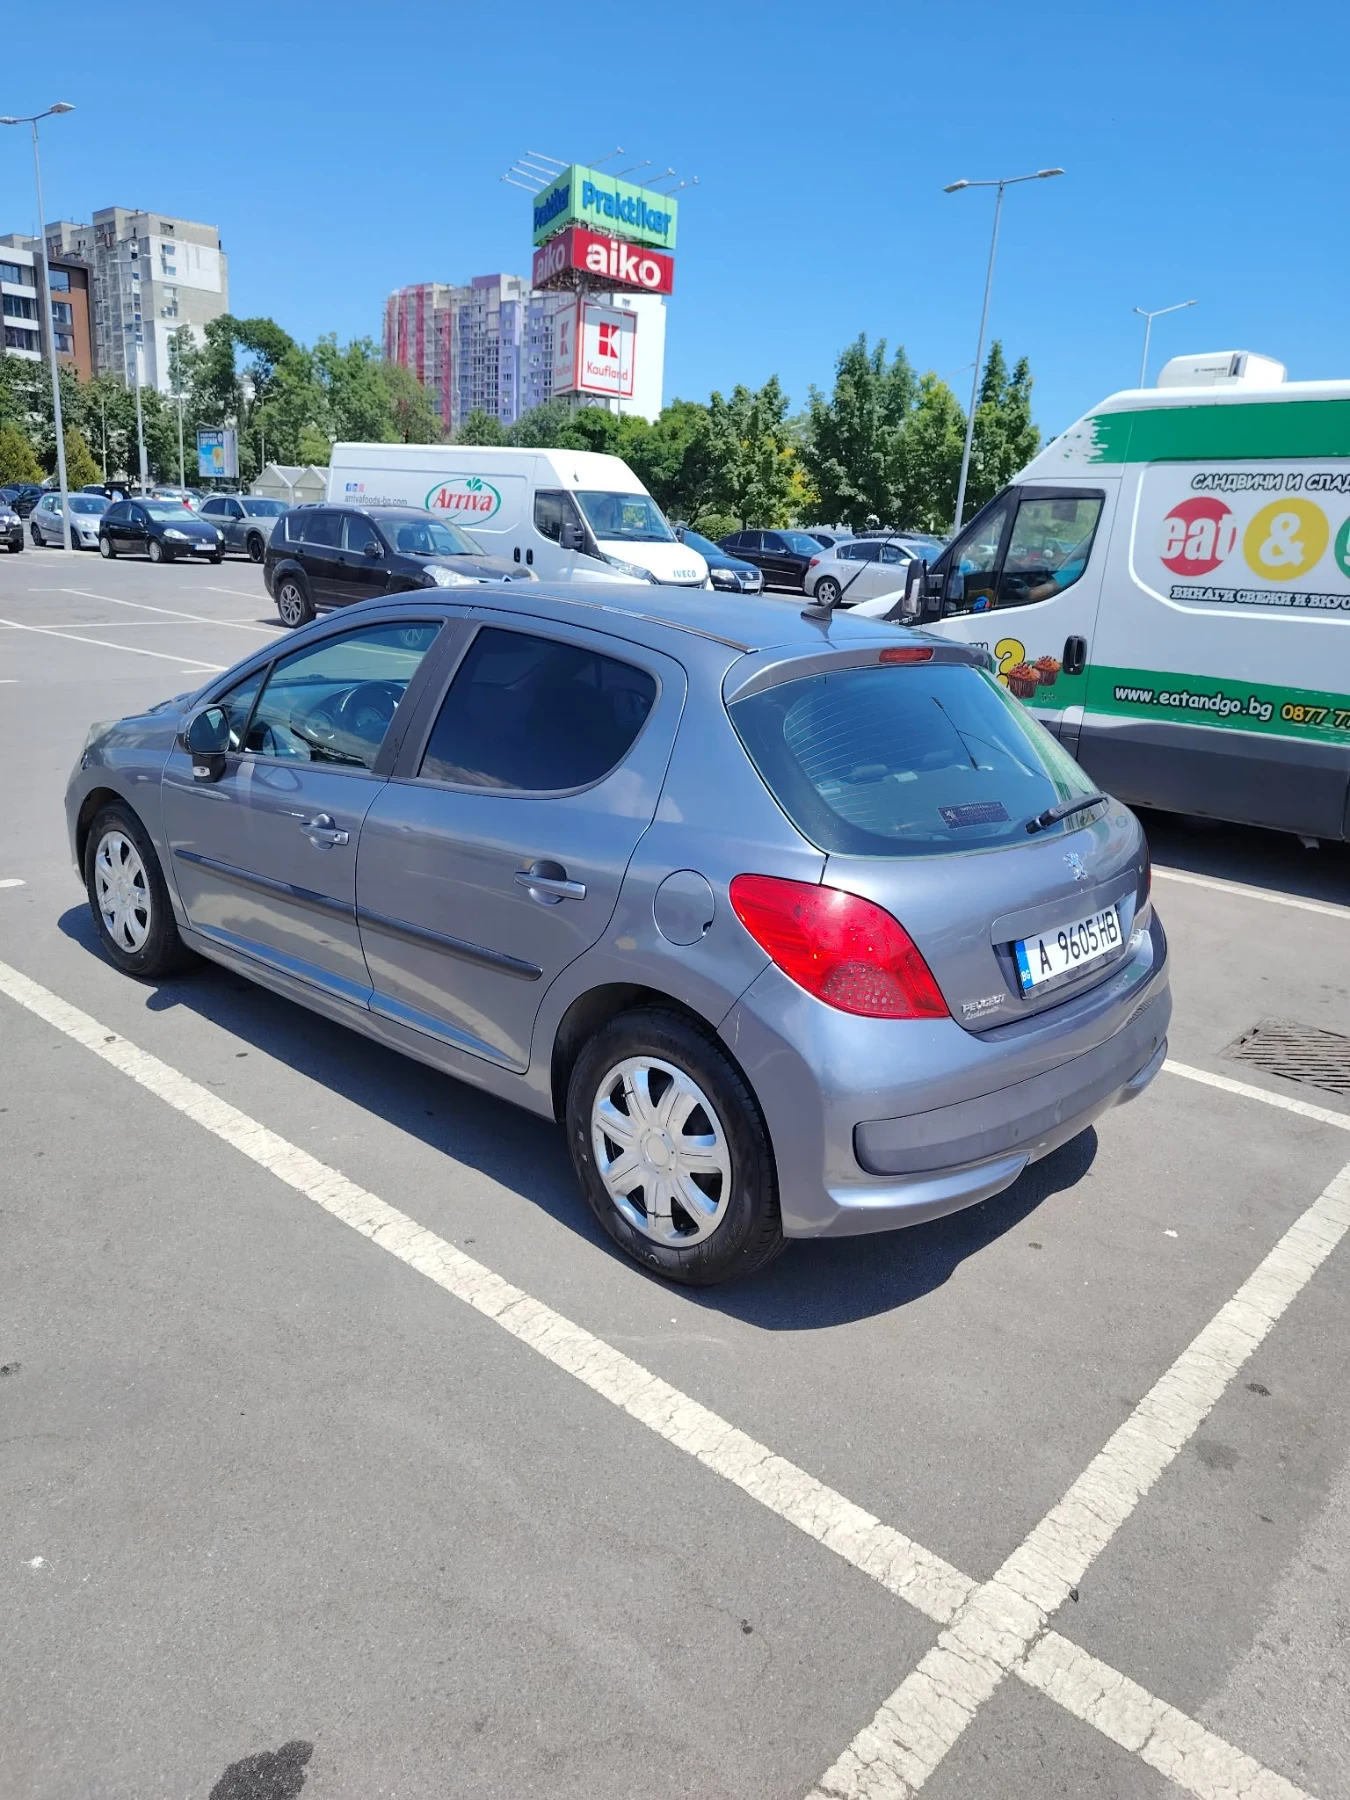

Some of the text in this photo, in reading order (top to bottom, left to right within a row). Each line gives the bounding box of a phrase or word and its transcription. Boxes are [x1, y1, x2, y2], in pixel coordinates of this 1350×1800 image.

[582, 180, 672, 235] Praktiker
[536, 243, 565, 282] aiko
[586, 241, 661, 287] aiko
[587, 361, 628, 381] Kaufland
[1191, 473, 1283, 492] САНДВИЧИ
[1285, 473, 1303, 491] И
[432, 488, 493, 512] Arriva
[1157, 513, 1236, 562] eat
[673, 569, 697, 578] IVECO
[1170, 585, 1237, 602] ВИНАГИ
[1236, 588, 1293, 607] СВЕЖИ
[1293, 592, 1308, 607] И
[1114, 685, 1274, 721] www.eatandgo.bg
[1280, 703, 1329, 724] 0877
[1039, 939, 1052, 975] A
[1020, 969, 1031, 983] BG
[962, 993, 1006, 1014] PEUGEOT
